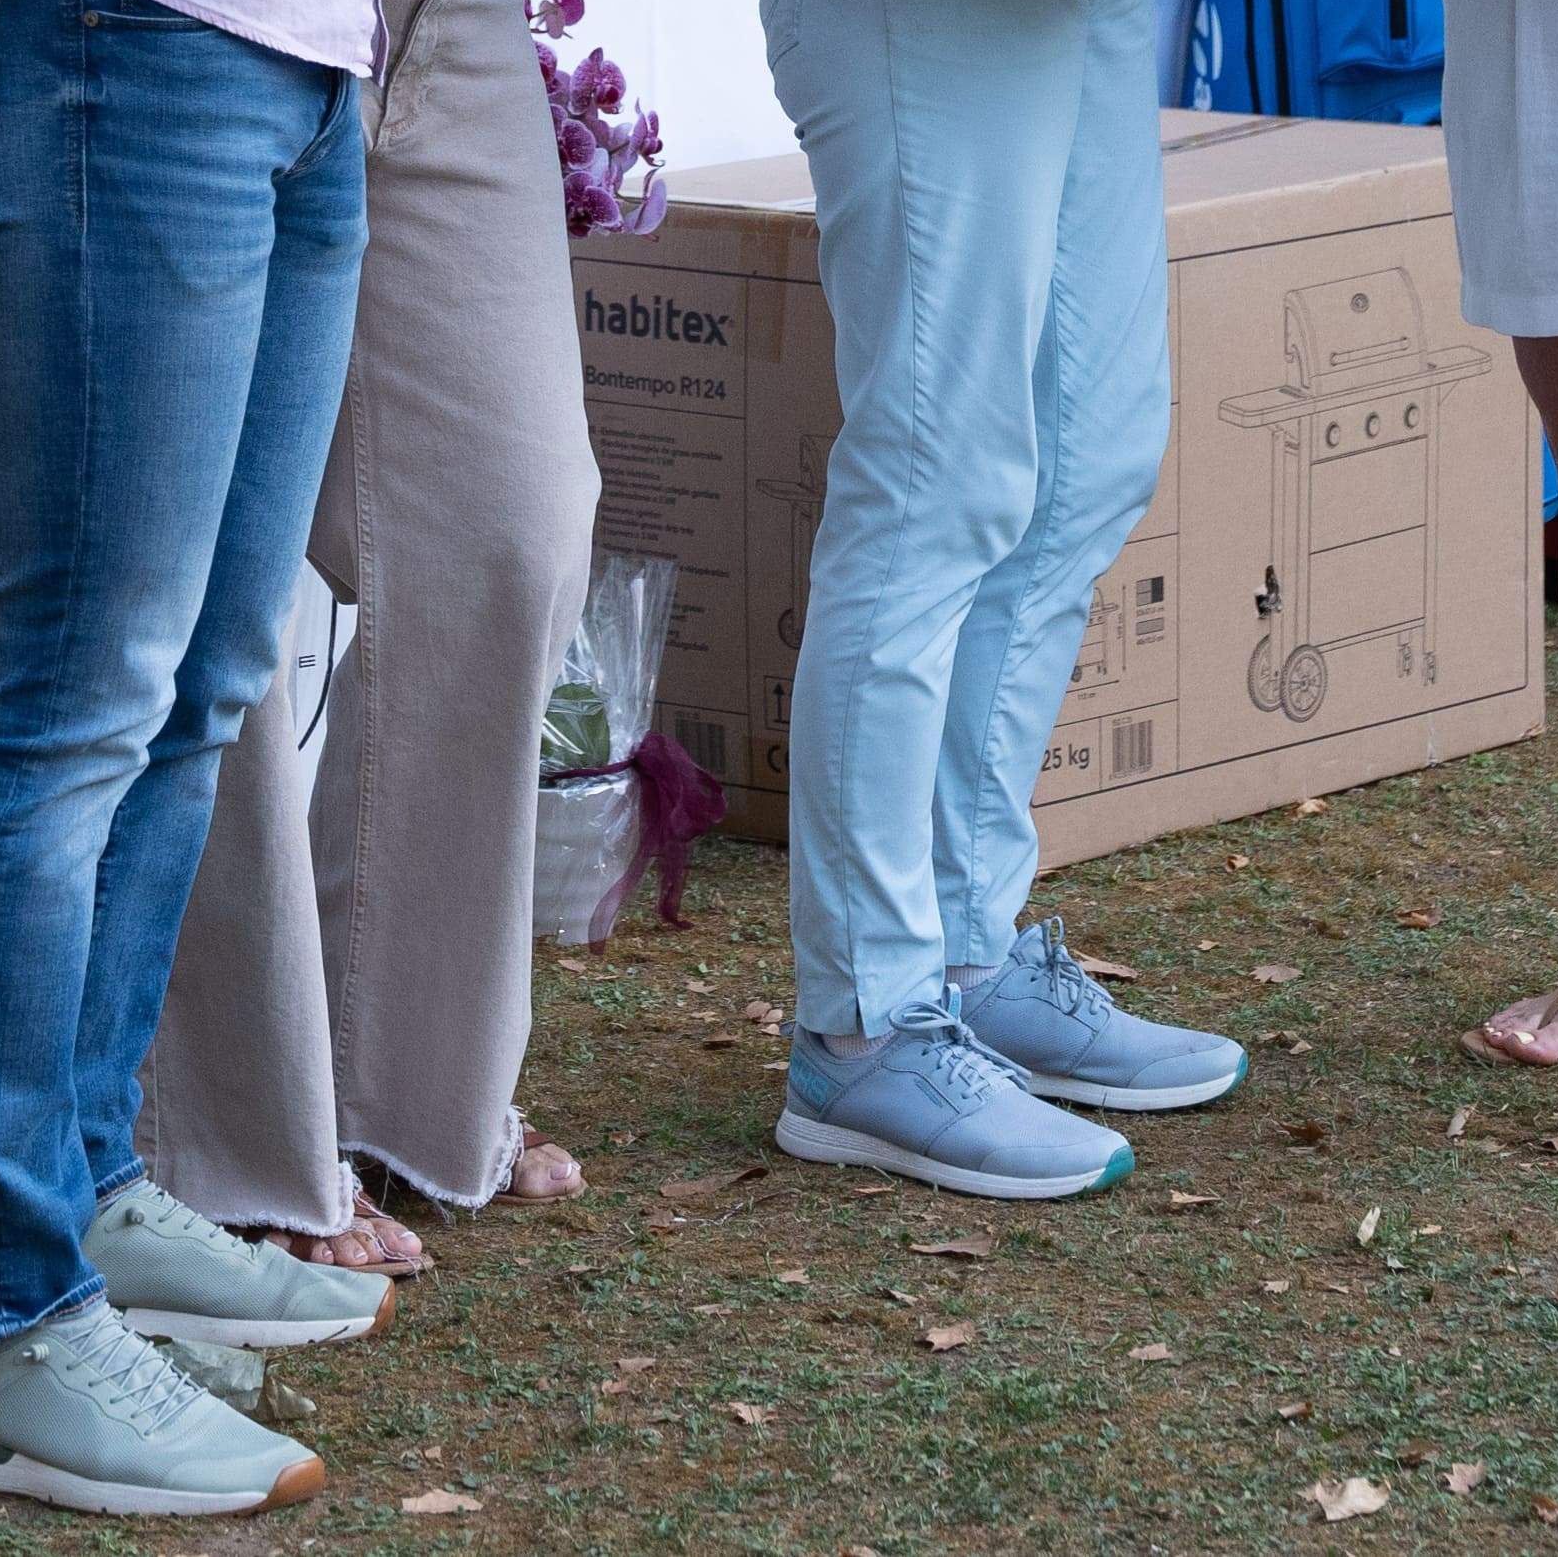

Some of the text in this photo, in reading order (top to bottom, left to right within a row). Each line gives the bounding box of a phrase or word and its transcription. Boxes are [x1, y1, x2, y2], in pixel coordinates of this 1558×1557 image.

[585, 288, 729, 346] habitex
[585, 365, 727, 400] Bontempo R124
[1068, 743, 1090, 770] kg
